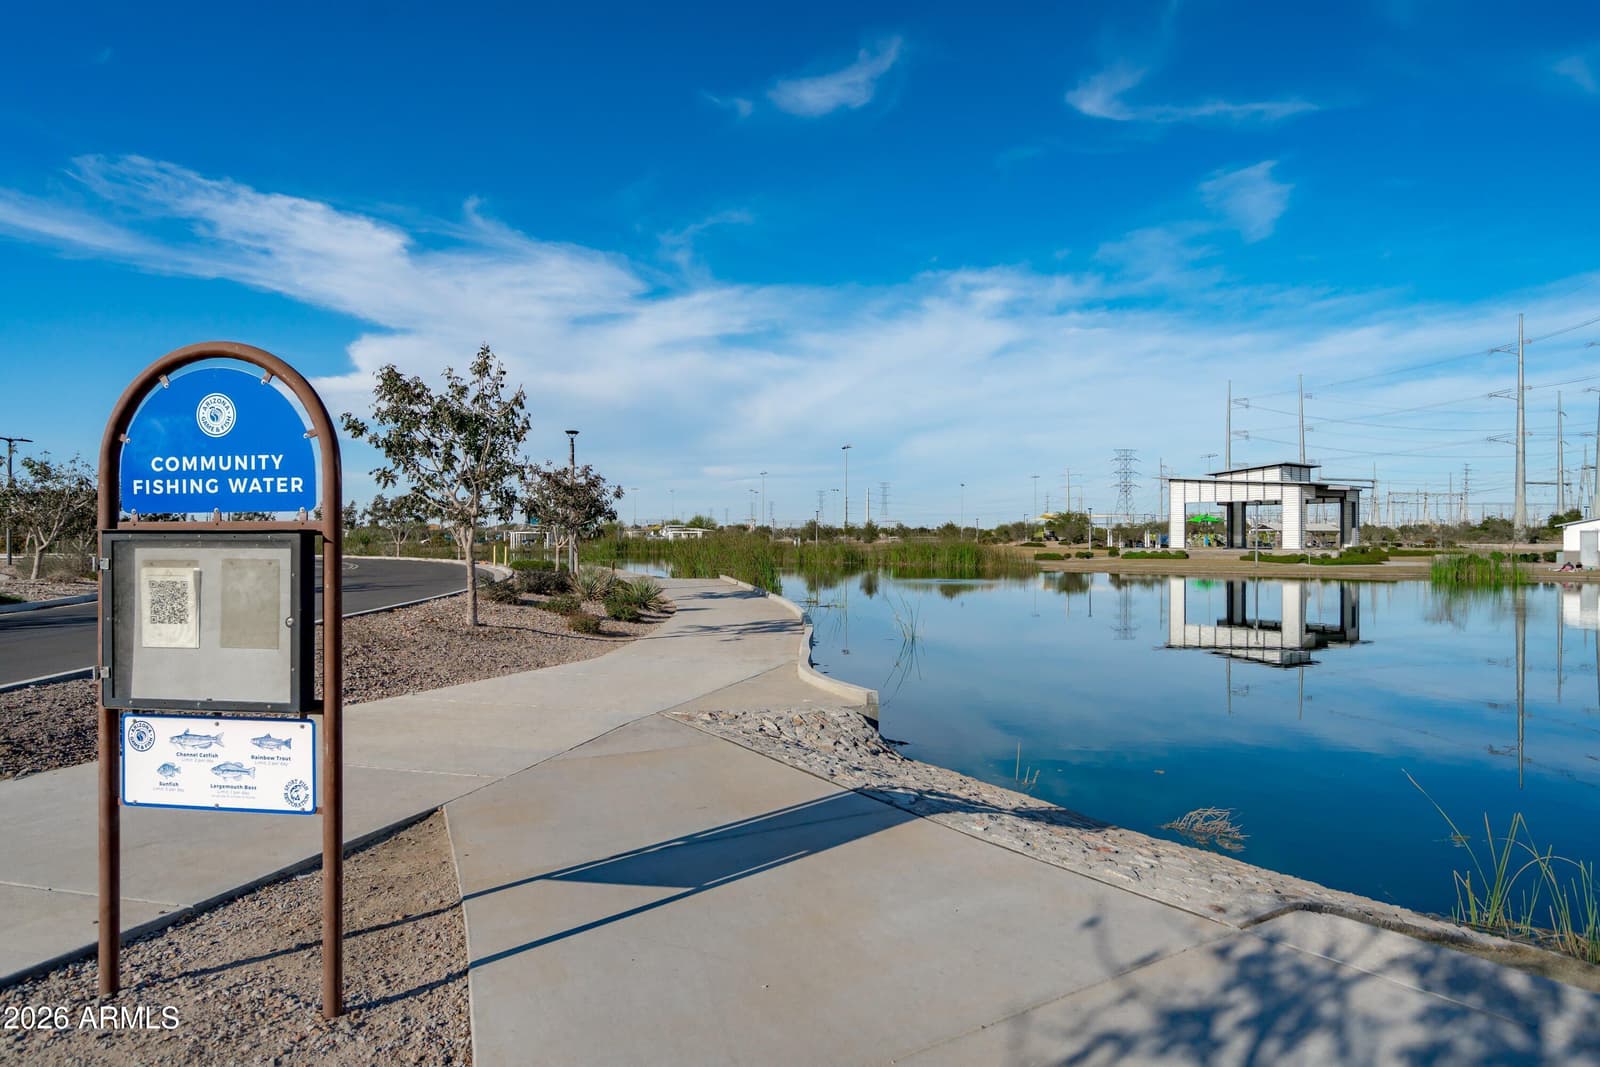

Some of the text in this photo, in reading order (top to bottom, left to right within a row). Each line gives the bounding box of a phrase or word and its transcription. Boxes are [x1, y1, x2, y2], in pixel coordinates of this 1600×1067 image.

[203, 398, 230, 411] ARIZONA
[201, 416, 215, 432] GAME
[220, 415, 232, 431] FISH
[151, 454, 284, 472] COMMUNITY
[132, 477, 304, 495] FISHING WATER
[210, 783, 243, 791] Largemouth
